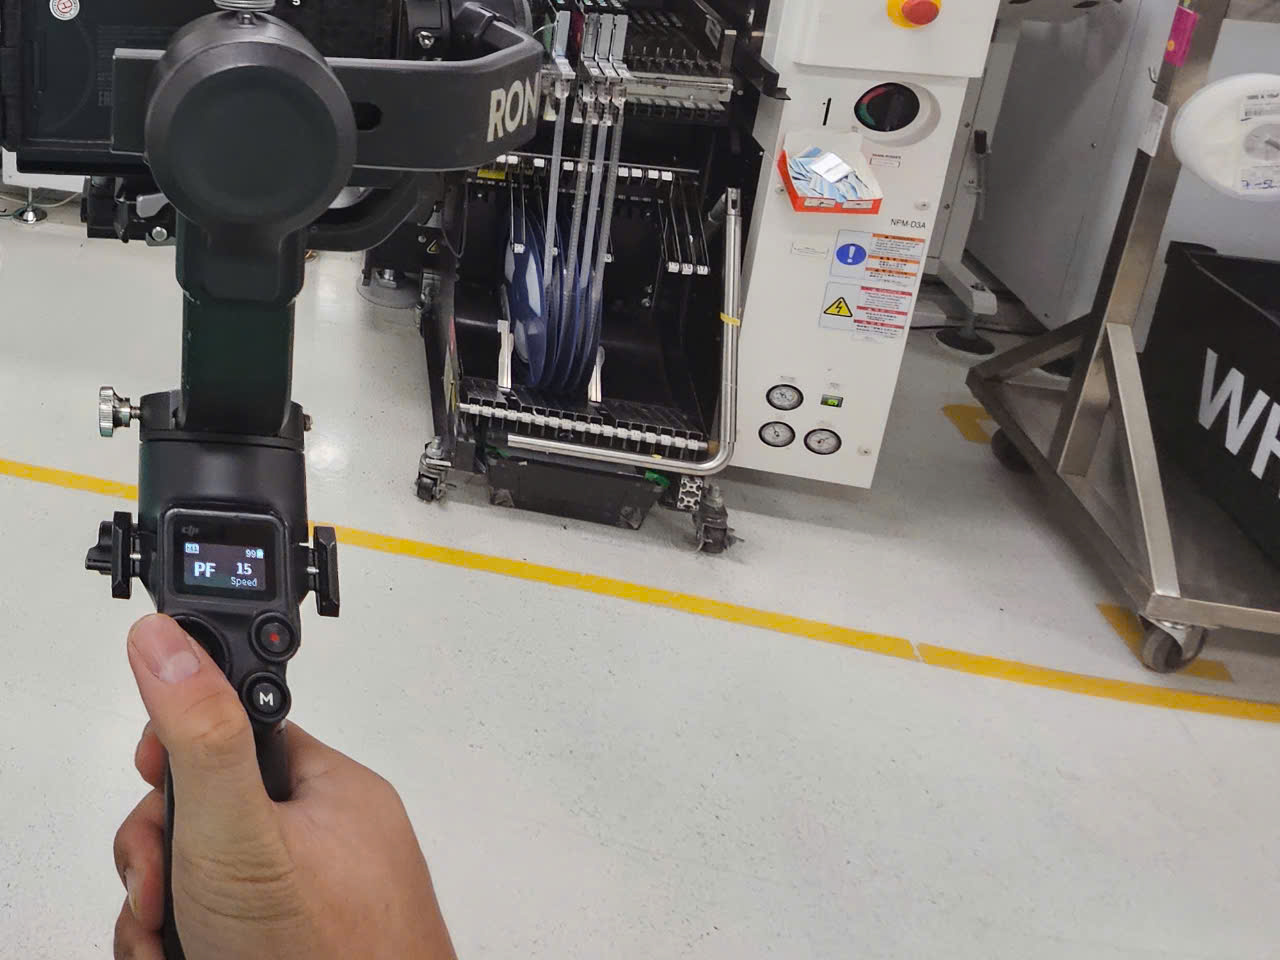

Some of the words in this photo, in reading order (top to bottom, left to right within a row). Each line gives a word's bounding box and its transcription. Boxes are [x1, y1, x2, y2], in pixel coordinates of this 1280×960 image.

[890, 218, 926, 229] NPM-D3A
[245, 548, 257, 559] 99
[194, 561, 217, 578] PF
[236, 562, 253, 575] 15
[230, 576, 258, 588] Speed
[259, 691, 274, 707] M
